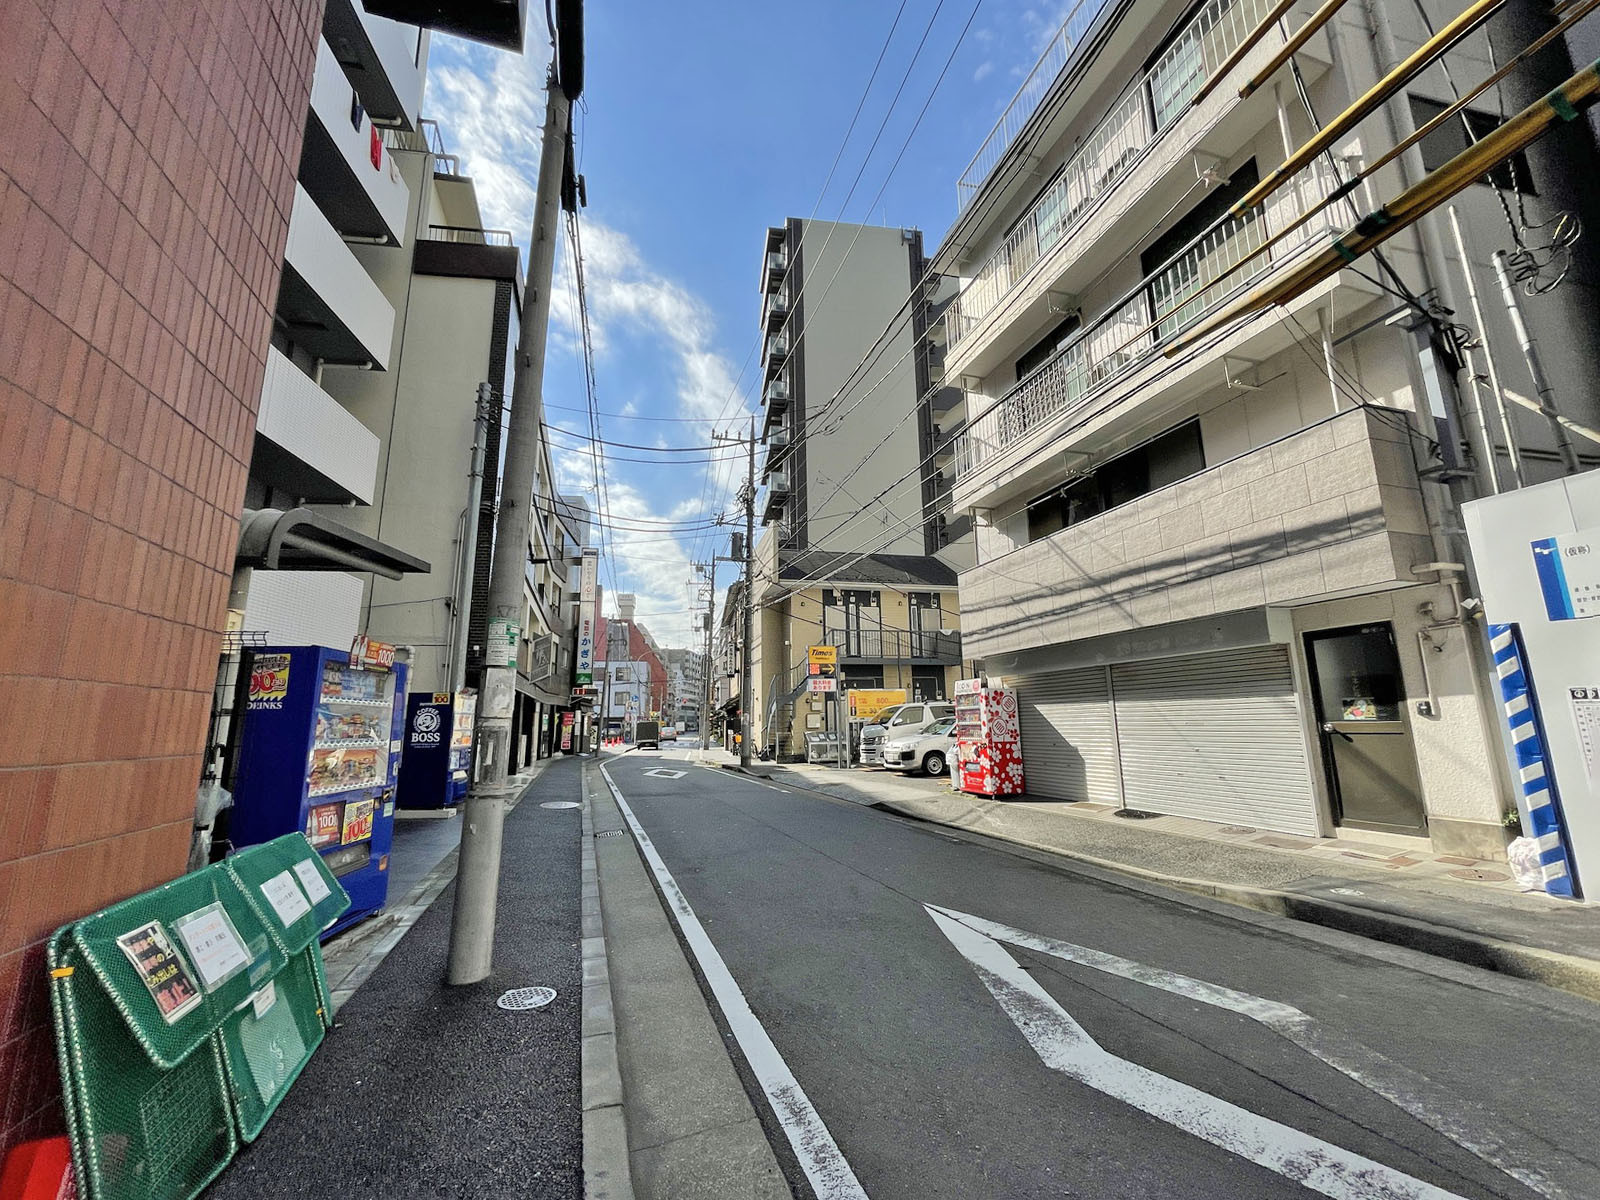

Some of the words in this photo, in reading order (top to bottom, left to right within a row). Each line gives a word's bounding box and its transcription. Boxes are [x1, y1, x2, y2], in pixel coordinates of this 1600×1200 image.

[580, 637, 591, 670] かぎや
[416, 707, 440, 716] COFFEE
[411, 732, 441, 743] BOSS
